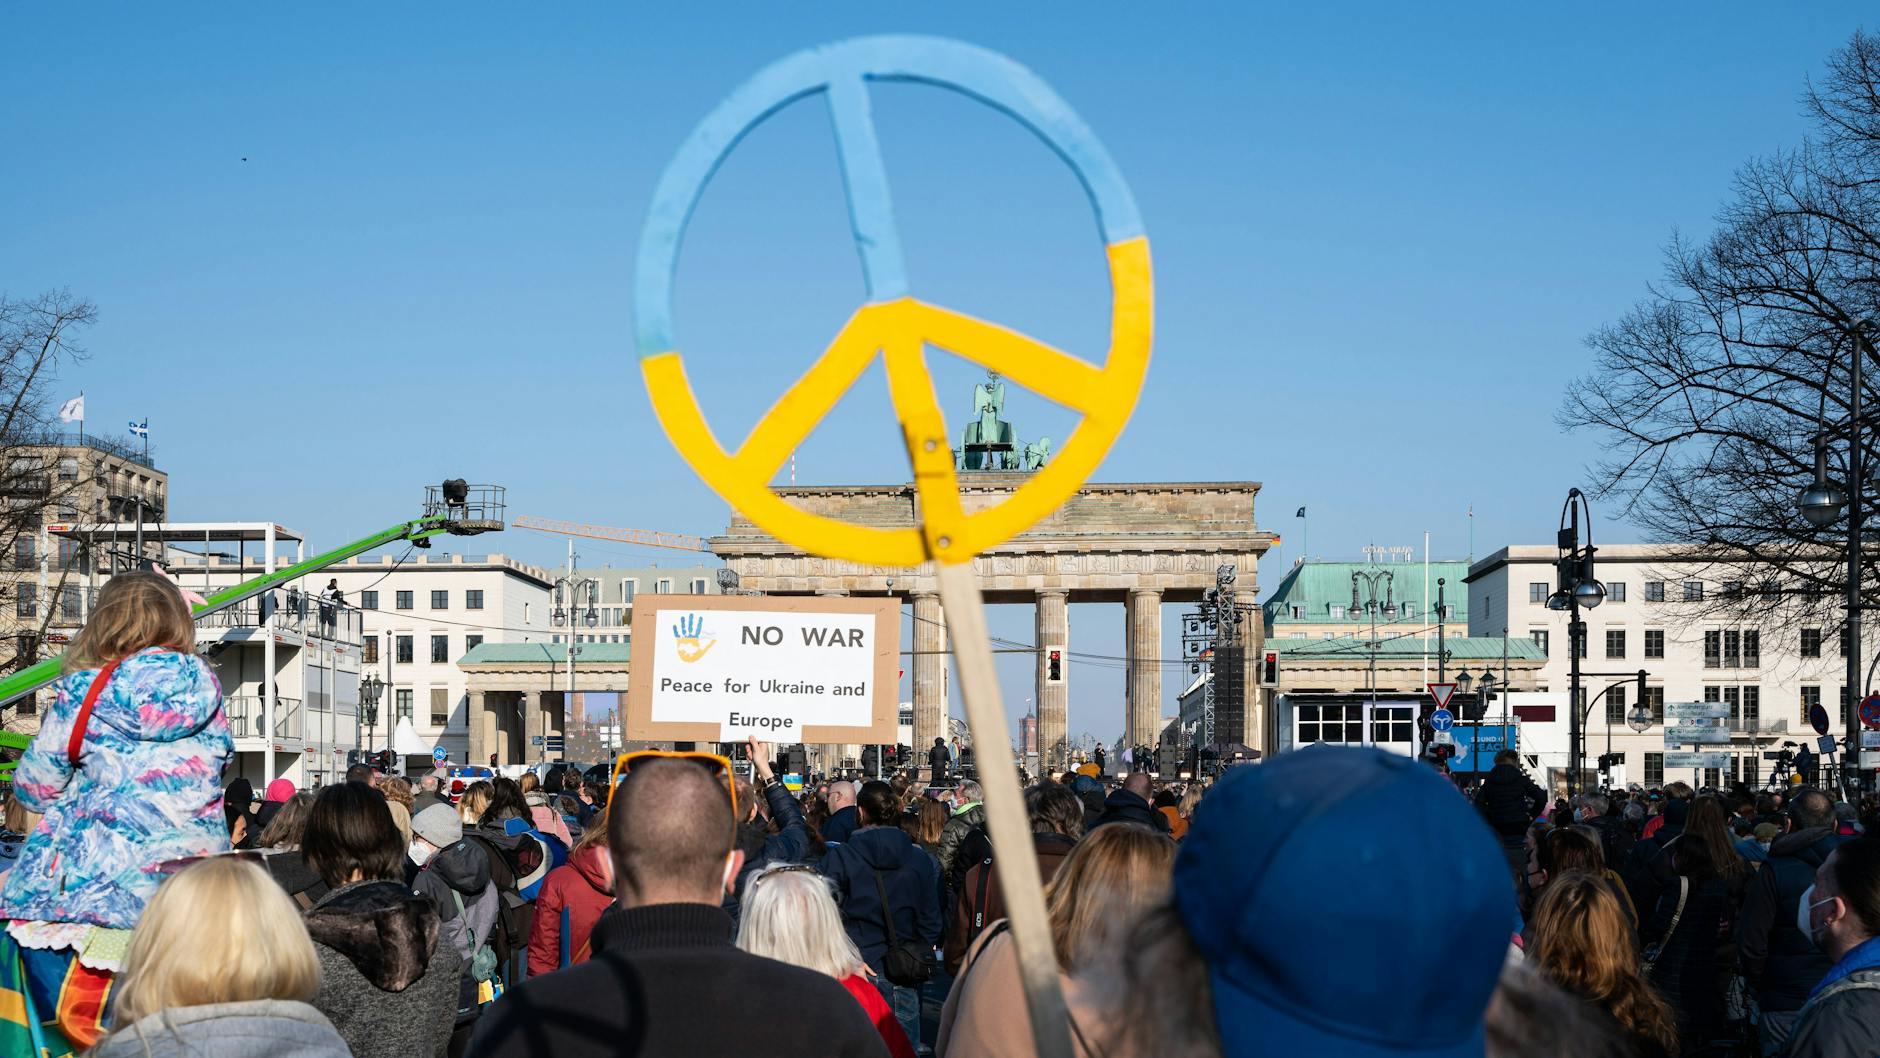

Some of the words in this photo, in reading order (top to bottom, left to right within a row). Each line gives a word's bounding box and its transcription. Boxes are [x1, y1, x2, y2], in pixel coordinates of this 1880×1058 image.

[741, 625, 784, 646] NO
[801, 627, 864, 647] WAR
[661, 678, 713, 693] Peace
[724, 678, 750, 694] for
[760, 679, 825, 695] Ukraine
[832, 682, 865, 696] and
[729, 712, 793, 731] Europe
